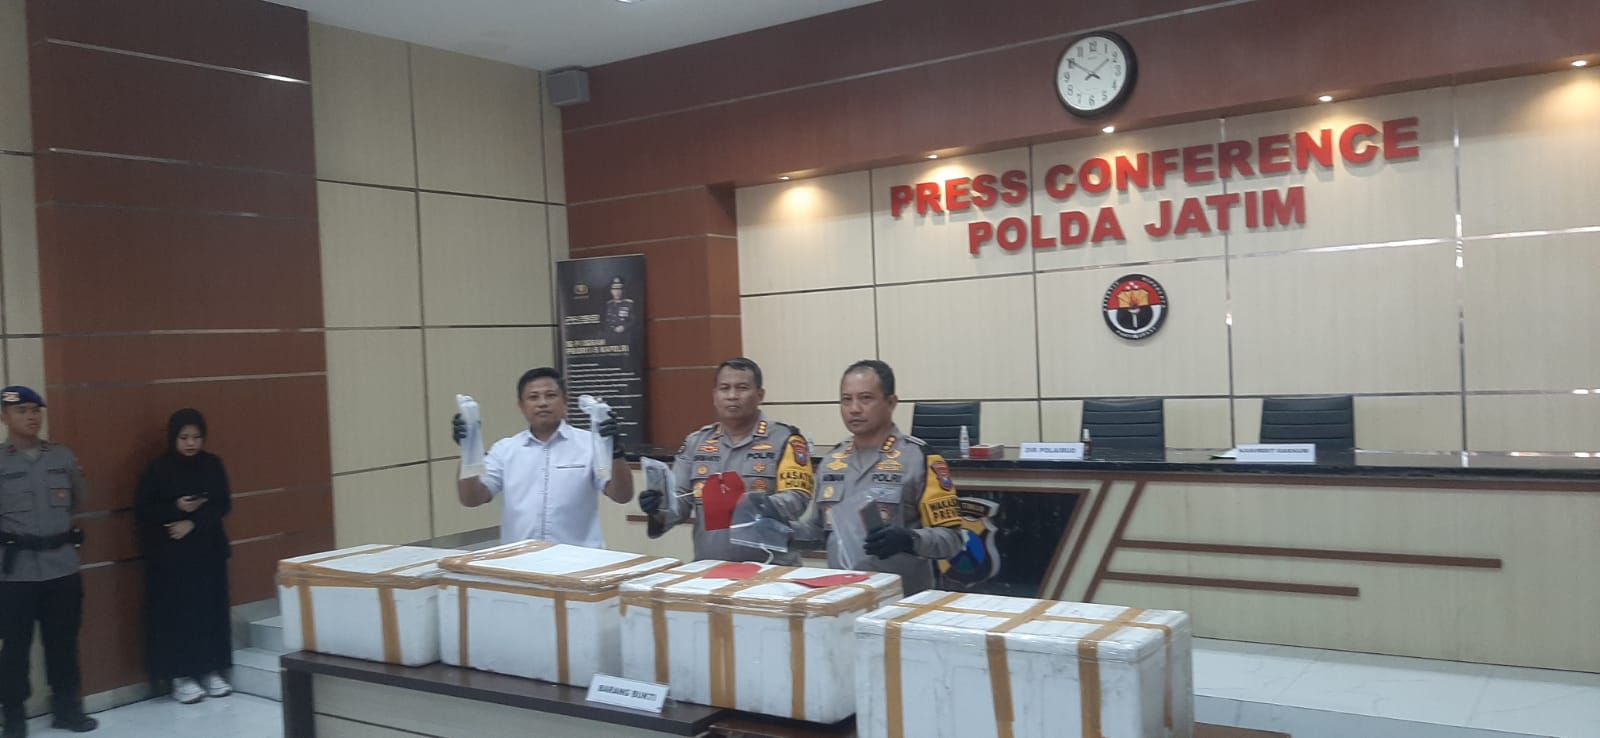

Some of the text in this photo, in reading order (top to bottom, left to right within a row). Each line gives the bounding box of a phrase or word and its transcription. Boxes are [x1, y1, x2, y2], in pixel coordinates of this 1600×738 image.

[1089, 40, 1097, 52] 12
[1104, 43, 1108, 54] 1
[1089, 95, 1095, 106] 6
[890, 117, 1420, 217] PRESS CONFERENCE
[968, 185, 1307, 255] POLDA JATIM
[872, 474, 904, 482] POLRI
[598, 685, 657, 701] BARANG BUKTI
